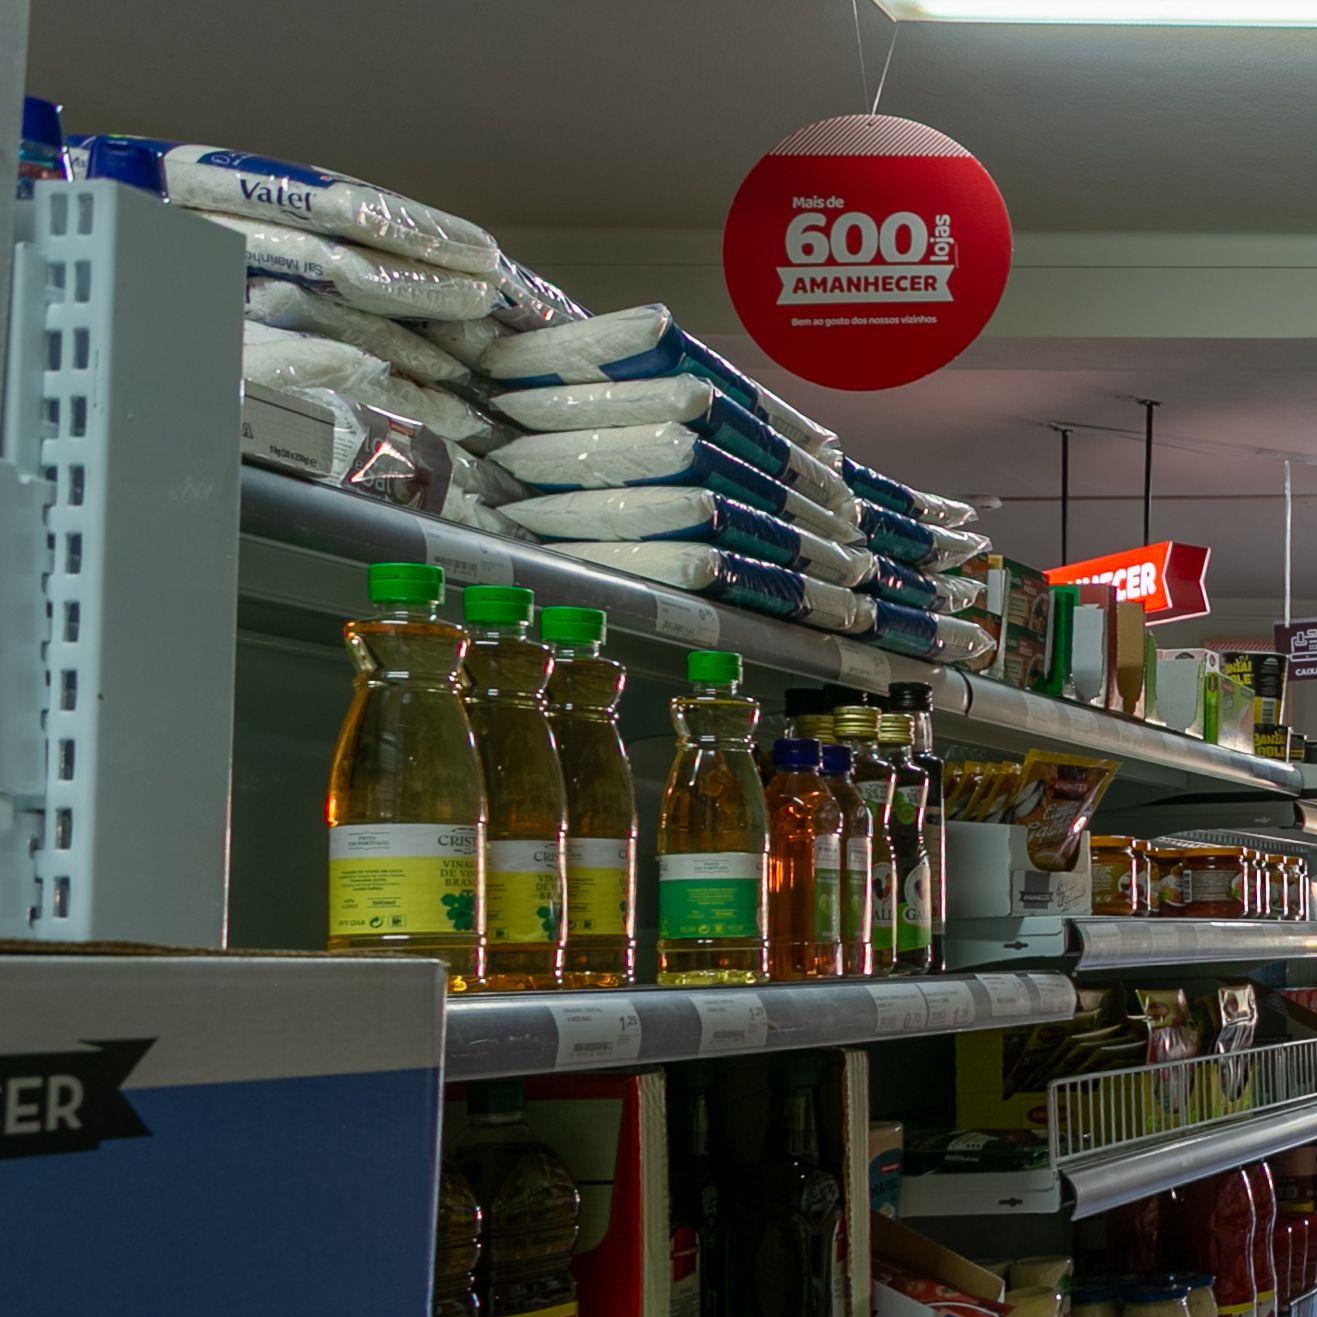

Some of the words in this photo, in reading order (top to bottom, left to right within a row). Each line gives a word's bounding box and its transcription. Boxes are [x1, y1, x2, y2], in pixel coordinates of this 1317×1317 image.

[792, 196, 825, 209] Mais
[826, 196, 844, 209] de
[785, 211, 928, 264] 600
[929, 214, 954, 261] lojas
[792, 275, 937, 294] AMANHECER
[792, 317, 811, 326] Bem
[825, 317, 850, 327] gosto
[851, 316, 868, 325] dos
[869, 317, 899, 325] nossos
[900, 314, 937, 324] vizinhos
[438, 834, 477, 848] CRIST
